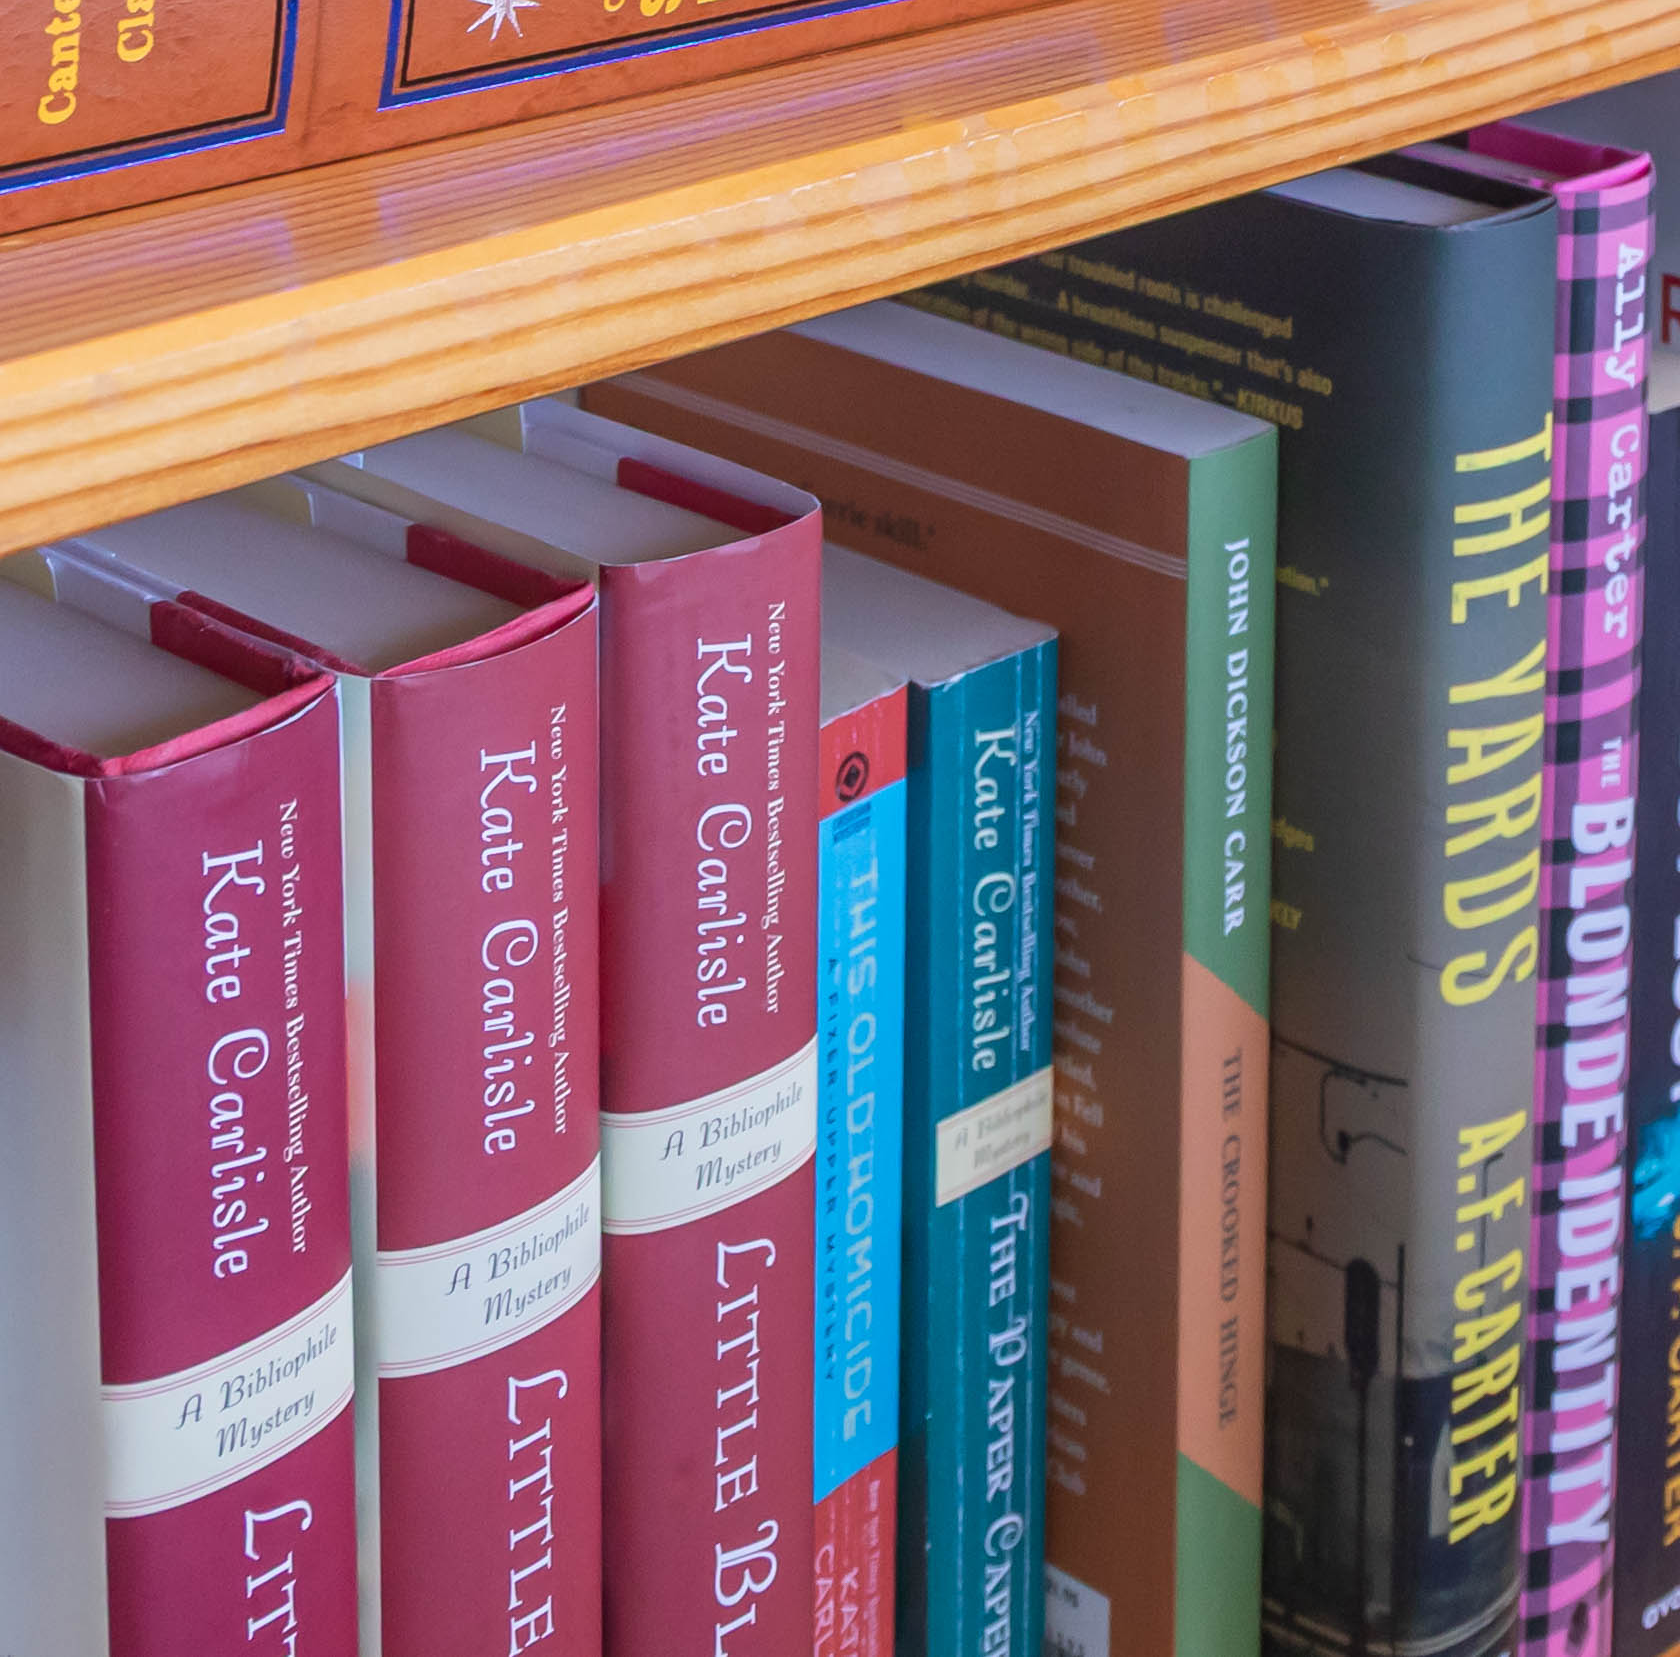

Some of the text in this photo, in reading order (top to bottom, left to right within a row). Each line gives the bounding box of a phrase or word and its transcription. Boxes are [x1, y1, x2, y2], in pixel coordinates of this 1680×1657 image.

[1602, 244, 1645, 639] Ally Carter
[695, 633, 753, 1029] Kate Carlisle
[761, 600, 786, 1015] New York Times Bestselling Author
[1023, 709, 1039, 754] New
[1222, 537, 1251, 936] JOHN DICKSON CARR
[1440, 411, 1553, 1006] THE YARDS
[1600, 738, 1622, 788] THE
[279, 798, 312, 1253] New York Times Bestselling Author
[479, 741, 540, 1156] Kate Carlisle
[548, 703, 573, 1136] New York Times Bestselling Author
[846, 855, 879, 995] THIS
[972, 728, 1017, 1073] Kate Carlisle
[201, 839, 270, 1279] Kate Carlisle
[658, 1081, 804, 1162] A Bibliophile
[693, 1139, 783, 1192] Mystery
[846, 1011, 878, 1137] OLD
[1546, 796, 1636, 1547] BLONDE IDENTITY
[174, 1323, 337, 1430] A Bibliophile
[444, 1200, 590, 1297] A Bibliophile
[483, 1263, 572, 1325] Mystery
[713, 1237, 776, 1514] LITTLE
[842, 1146, 877, 1442] HOMICIDE
[987, 1190, 1030, 1307] THE
[1218, 1048, 1242, 1430] THE CROOKED HINGE
[215, 1390, 316, 1458] Mystery
[507, 1368, 569, 1657] LITTLE
[985, 1316, 1029, 1504] PAPER
[1447, 1249, 1524, 1545] CARTER
